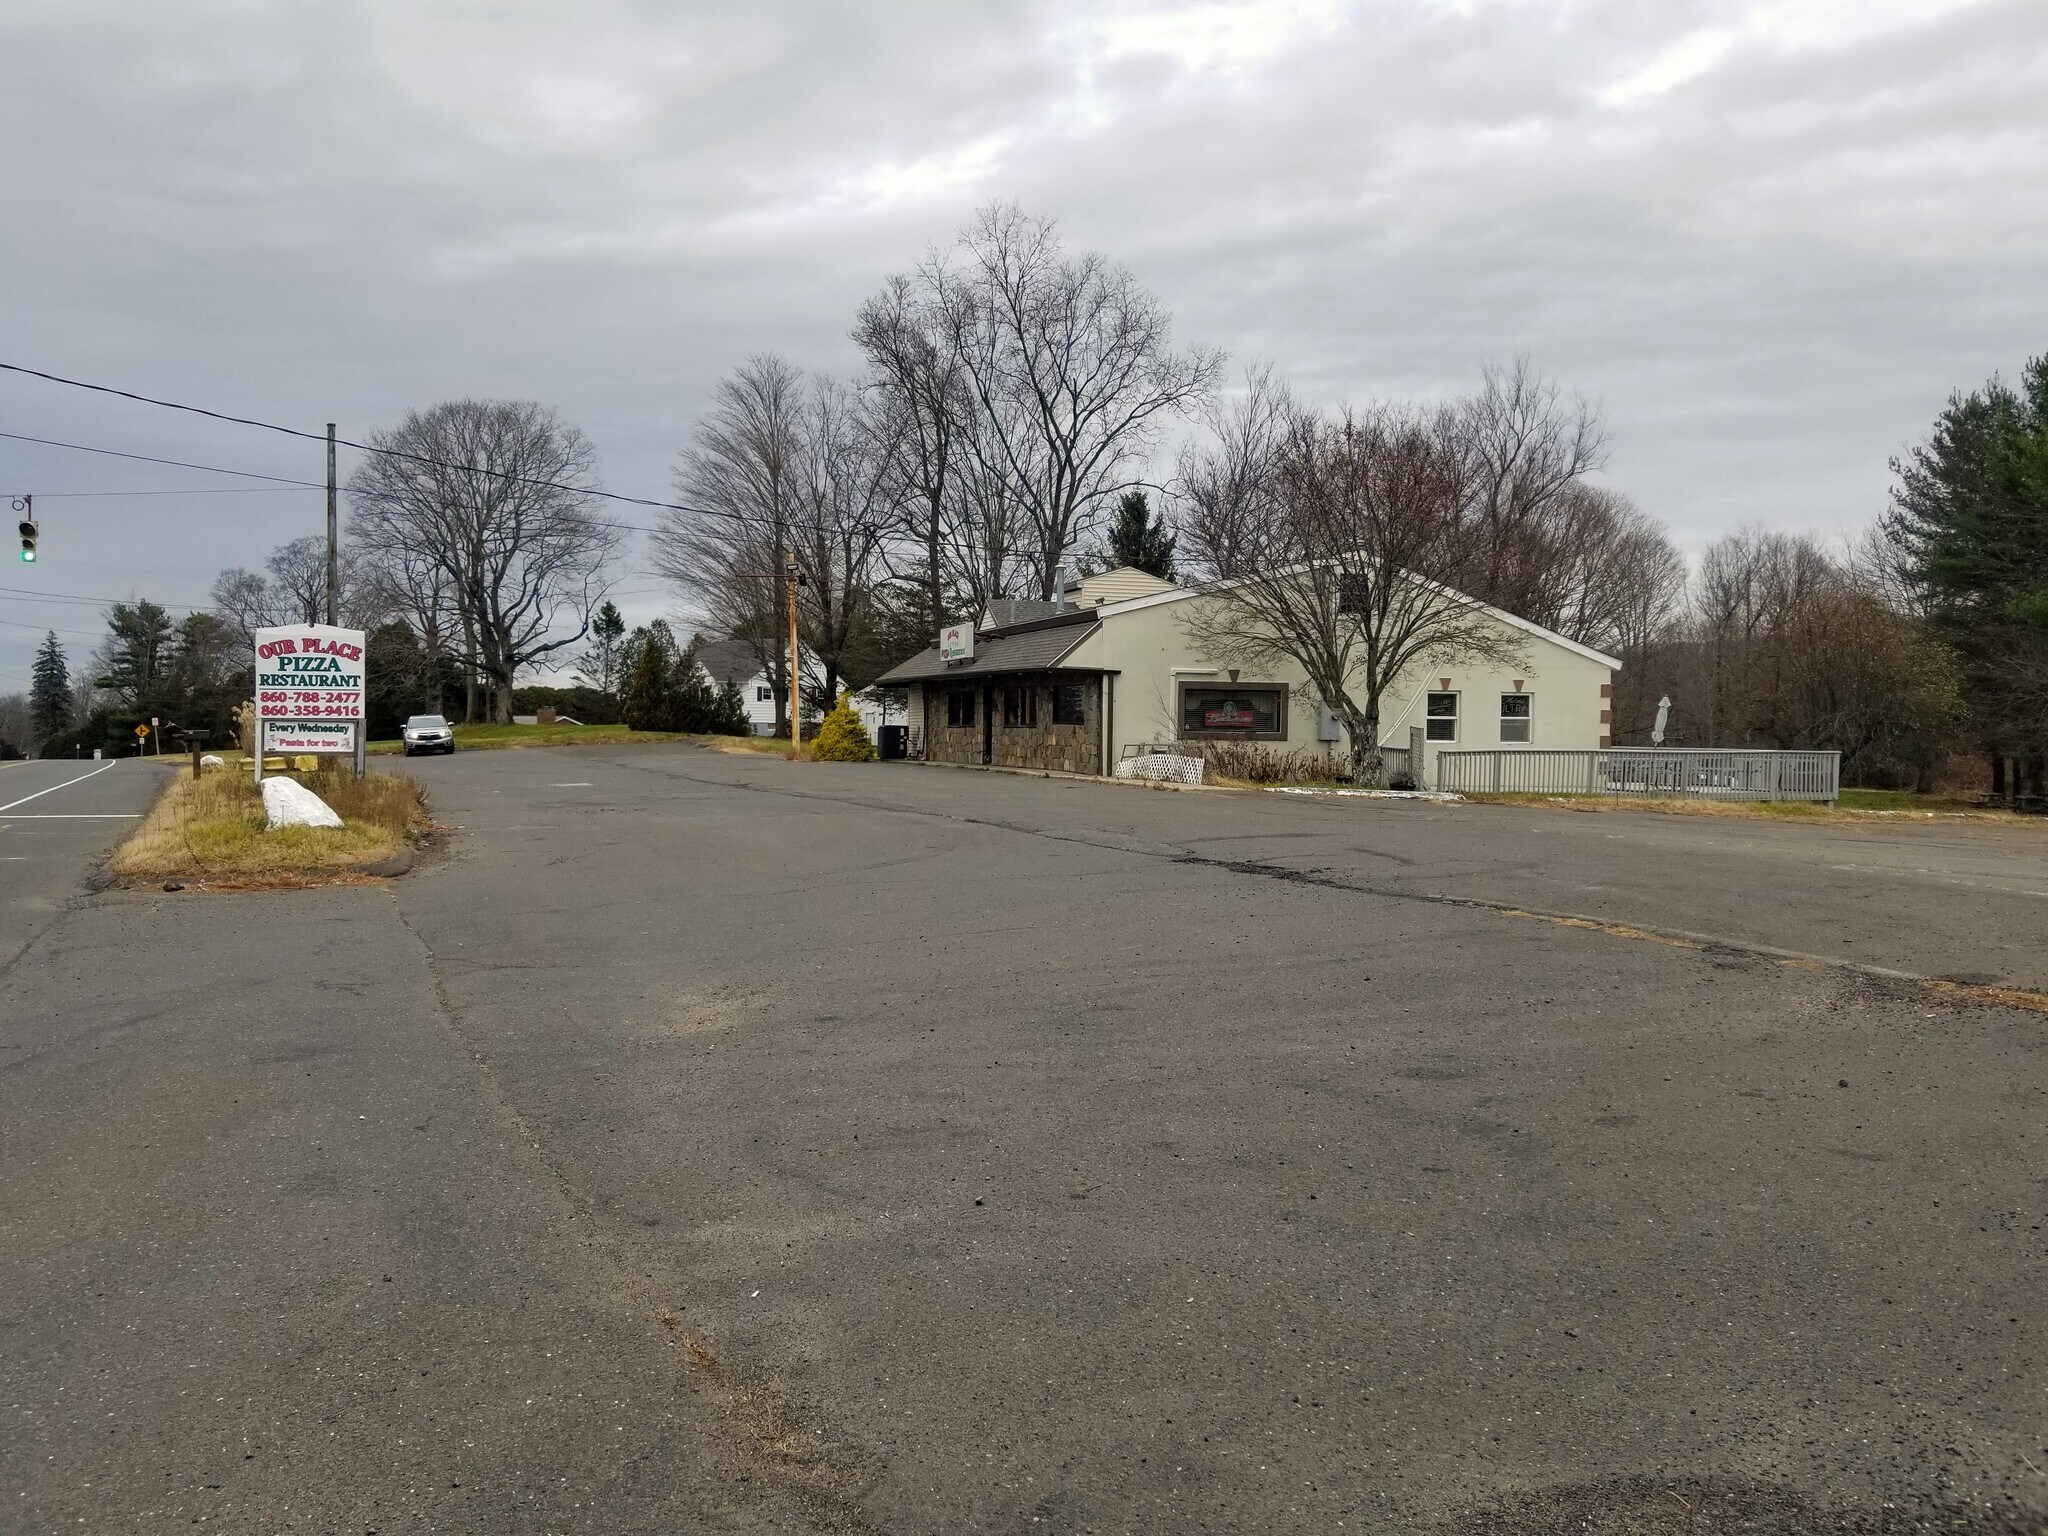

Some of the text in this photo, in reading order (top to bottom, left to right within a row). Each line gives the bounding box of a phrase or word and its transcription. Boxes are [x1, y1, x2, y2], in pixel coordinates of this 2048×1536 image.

[258, 638, 362, 661] OUR PLACE
[278, 657, 341, 672] PIZZA
[259, 674, 360, 687] RESTAURANT
[260, 692, 360, 703] 860-788-2477
[261, 705, 360, 716] 860-358-9416
[269, 723, 349, 734] Every Wednesday
[279, 738, 338, 747] Pasta for two
